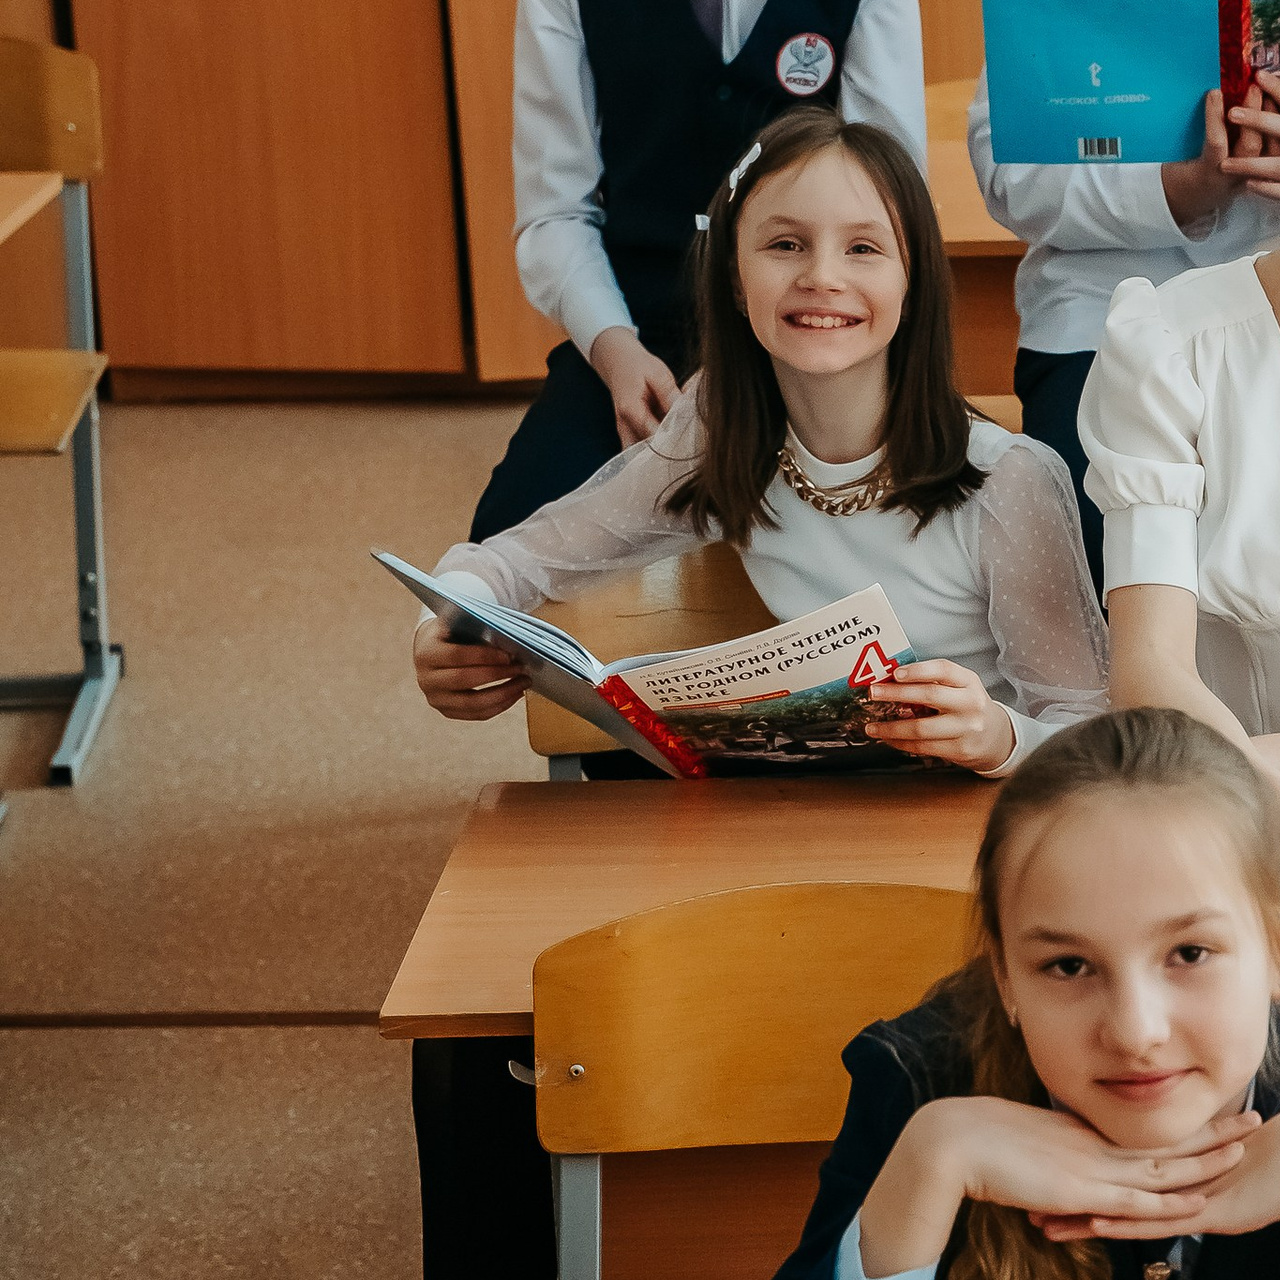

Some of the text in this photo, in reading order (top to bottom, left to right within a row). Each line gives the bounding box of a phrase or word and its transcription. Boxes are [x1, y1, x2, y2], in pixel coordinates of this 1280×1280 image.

[646, 615, 863, 688] ЛИТЕРАТУРНОЕ ЧТЕНИЕ
[652, 624, 882, 695] НА РОДНОМ (РУССКОМ)
[850, 642, 897, 687] 4
[660, 689, 731, 703] ЯЗЫКЕ
